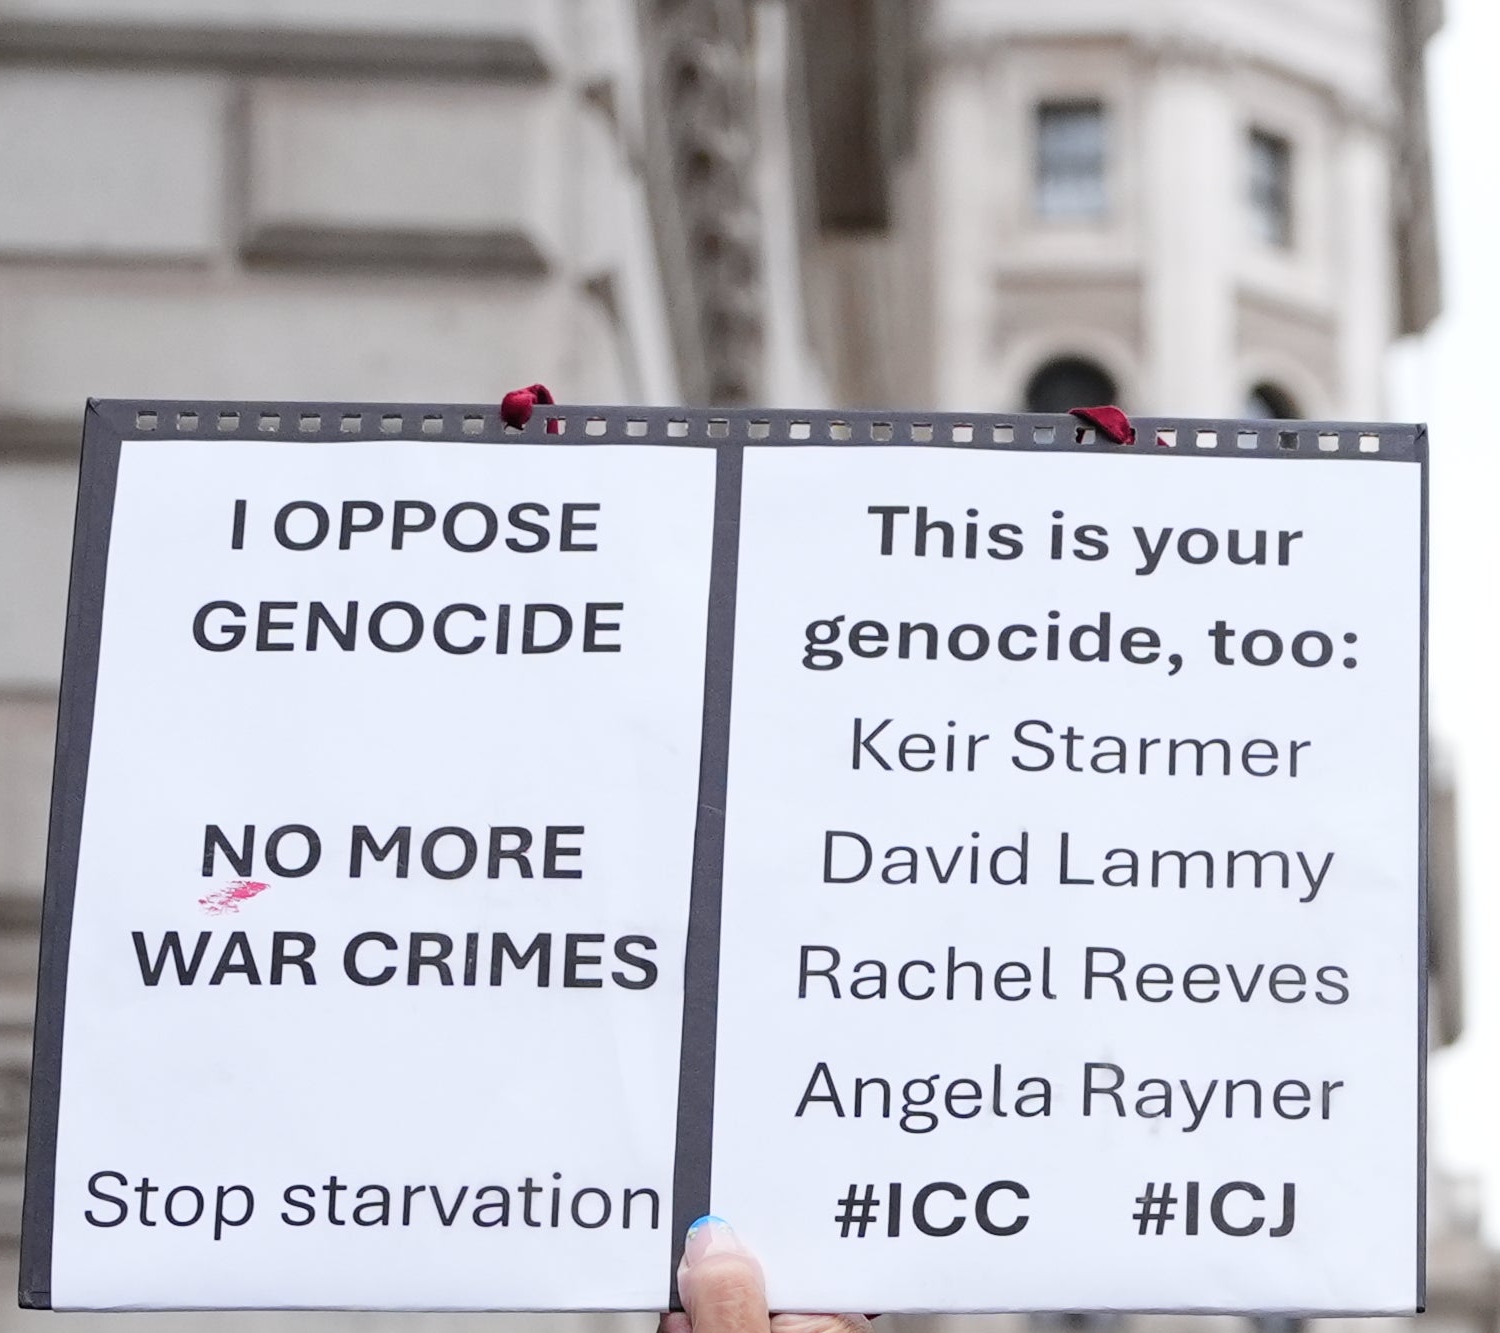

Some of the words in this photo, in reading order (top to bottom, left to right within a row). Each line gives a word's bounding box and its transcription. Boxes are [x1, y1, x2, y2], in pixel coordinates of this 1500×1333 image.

[229, 497, 249, 552] I
[272, 498, 603, 556] OPPOSE
[865, 503, 1026, 563] This
[1048, 508, 1111, 564] is
[1131, 524, 1305, 578] your
[190, 598, 626, 657] GENOCIDE
[800, 608, 1185, 678] genocide,
[1205, 618, 1360, 671] too:
[850, 715, 992, 774] Keir
[1009, 717, 1313, 780] Starmer
[199, 821, 324, 881] NO
[347, 822, 587, 883] MORE
[821, 828, 1031, 888] David
[1057, 830, 1336, 905] Lammy
[129, 928, 319, 989] WAR
[341, 929, 660, 993] CRIMES
[796, 943, 1059, 1004] Rachel
[1082, 944, 1351, 1007] Reeves
[793, 1060, 1054, 1136] Angela
[1081, 1060, 1346, 1135] Rayner
[82, 1168, 257, 1243] Stop
[281, 1173, 662, 1232] starvation
[832, 1178, 1032, 1240] #ICC
[1130, 1179, 1298, 1240] #ICJ
